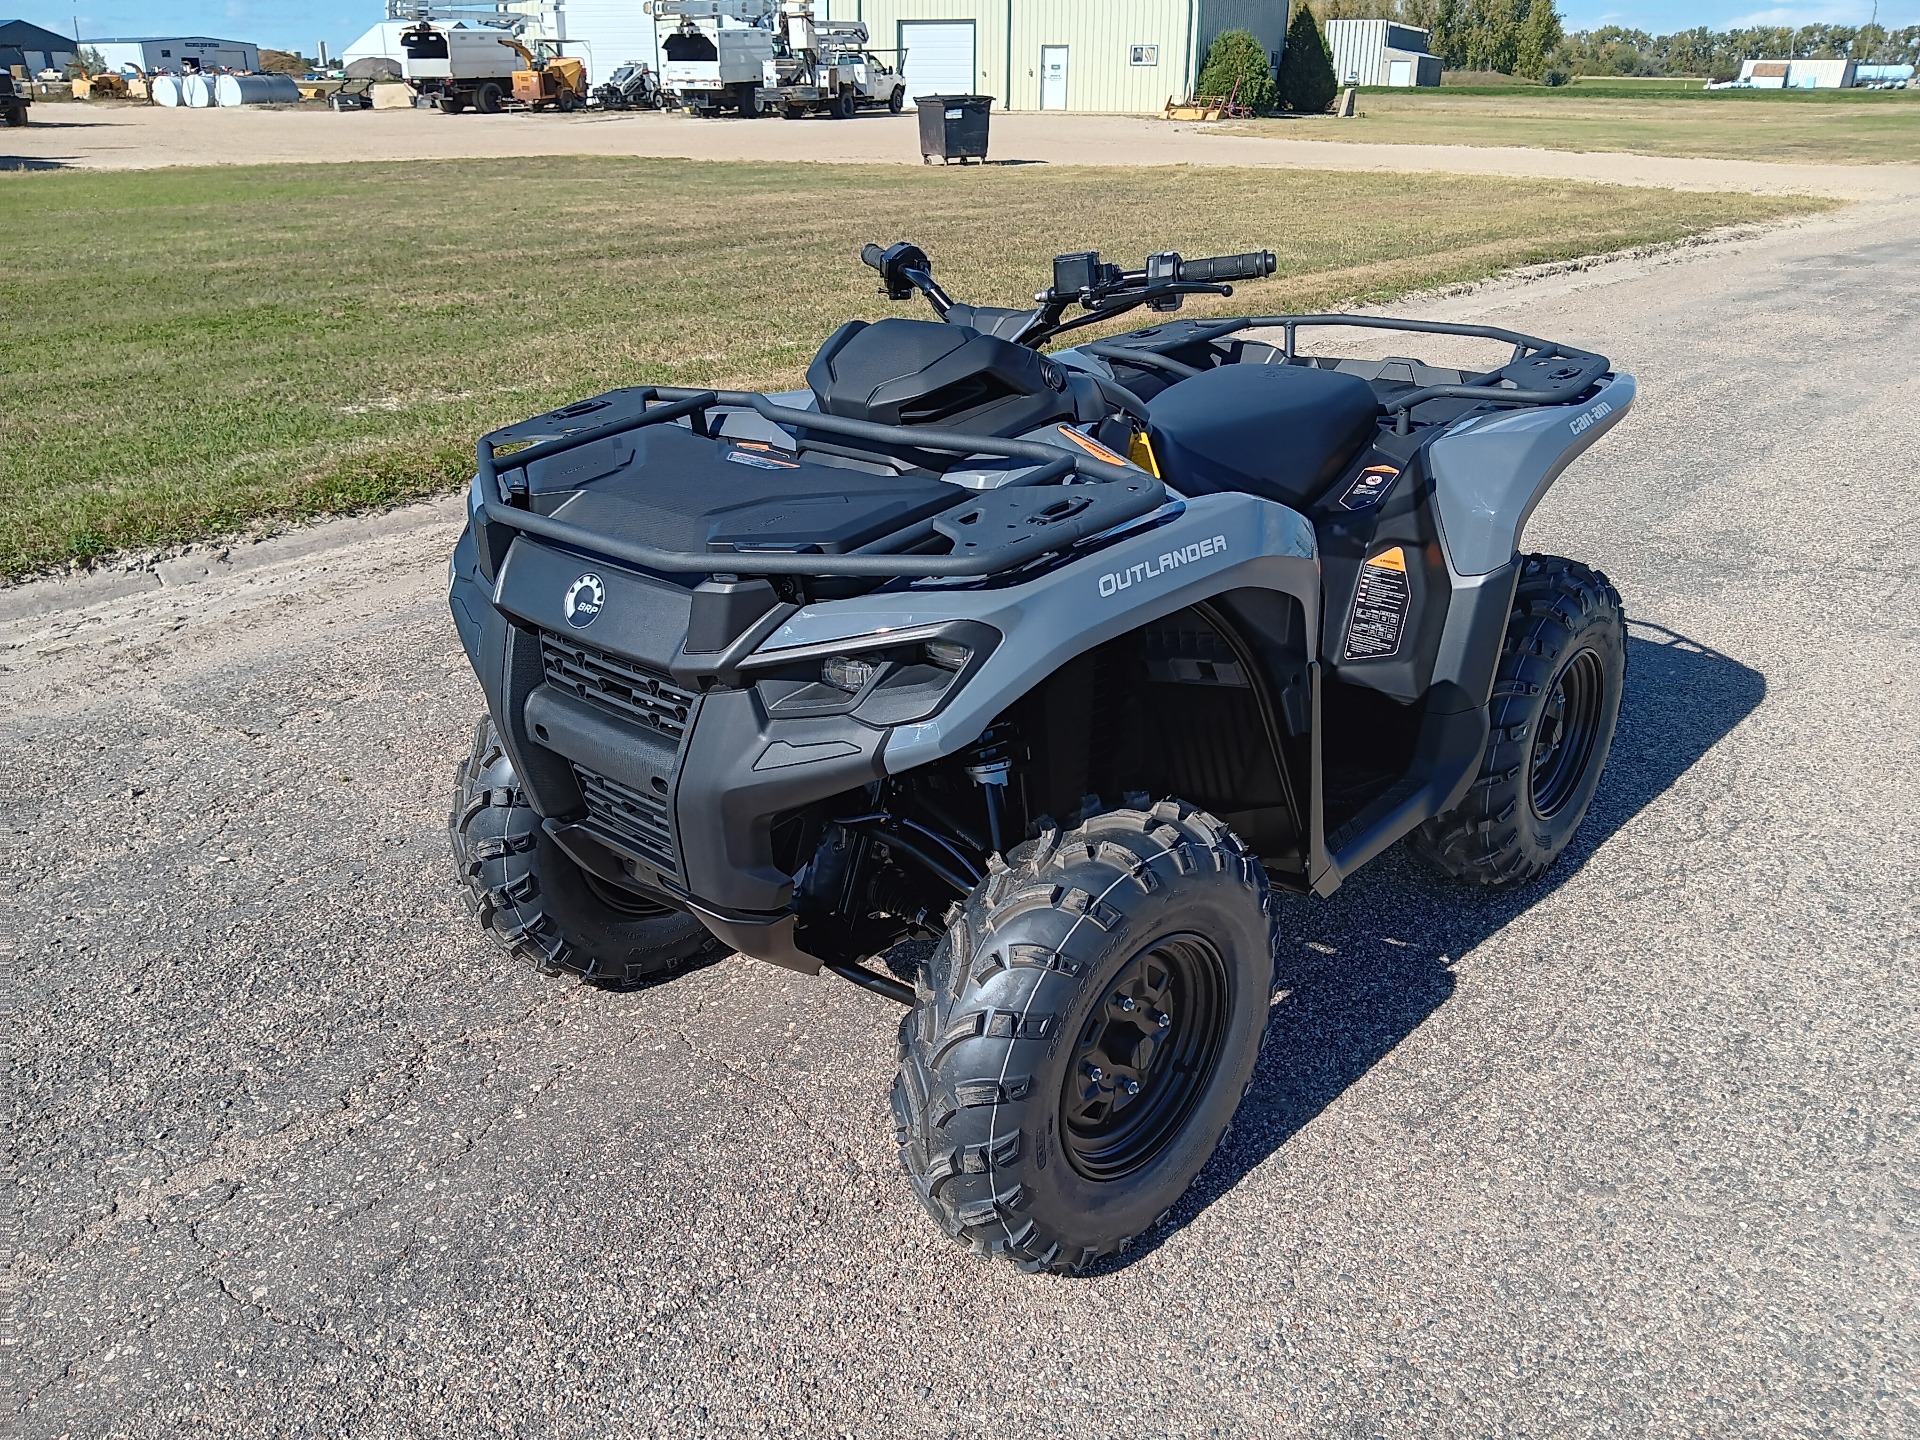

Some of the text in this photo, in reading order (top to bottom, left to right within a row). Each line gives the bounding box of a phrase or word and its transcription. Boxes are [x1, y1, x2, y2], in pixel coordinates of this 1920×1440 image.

[1568, 401, 1613, 436] can-am
[1098, 534, 1228, 598] OUTLANDER
[577, 602, 599, 615] BRP
